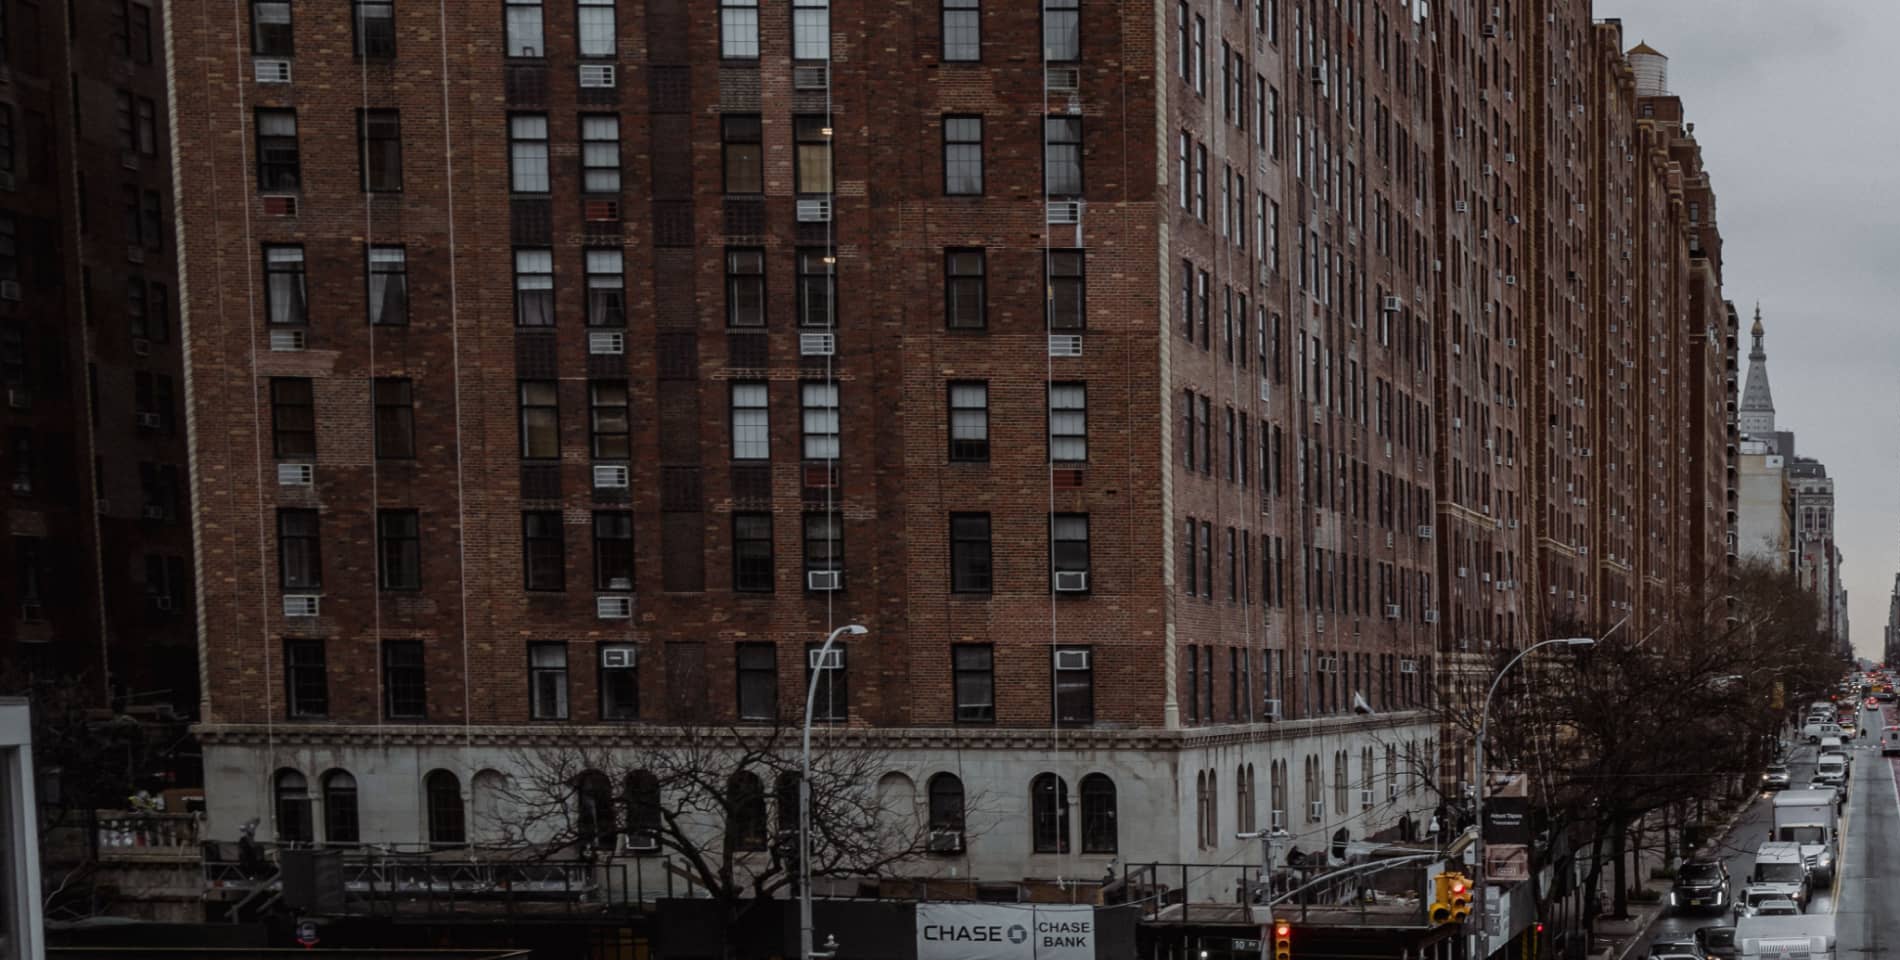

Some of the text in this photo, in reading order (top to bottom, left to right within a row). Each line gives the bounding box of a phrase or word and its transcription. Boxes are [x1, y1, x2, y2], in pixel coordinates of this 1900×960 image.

[923, 924, 1003, 942] CHASE
[1038, 921, 1090, 934] CHASE
[1043, 936, 1087, 948] BANK
